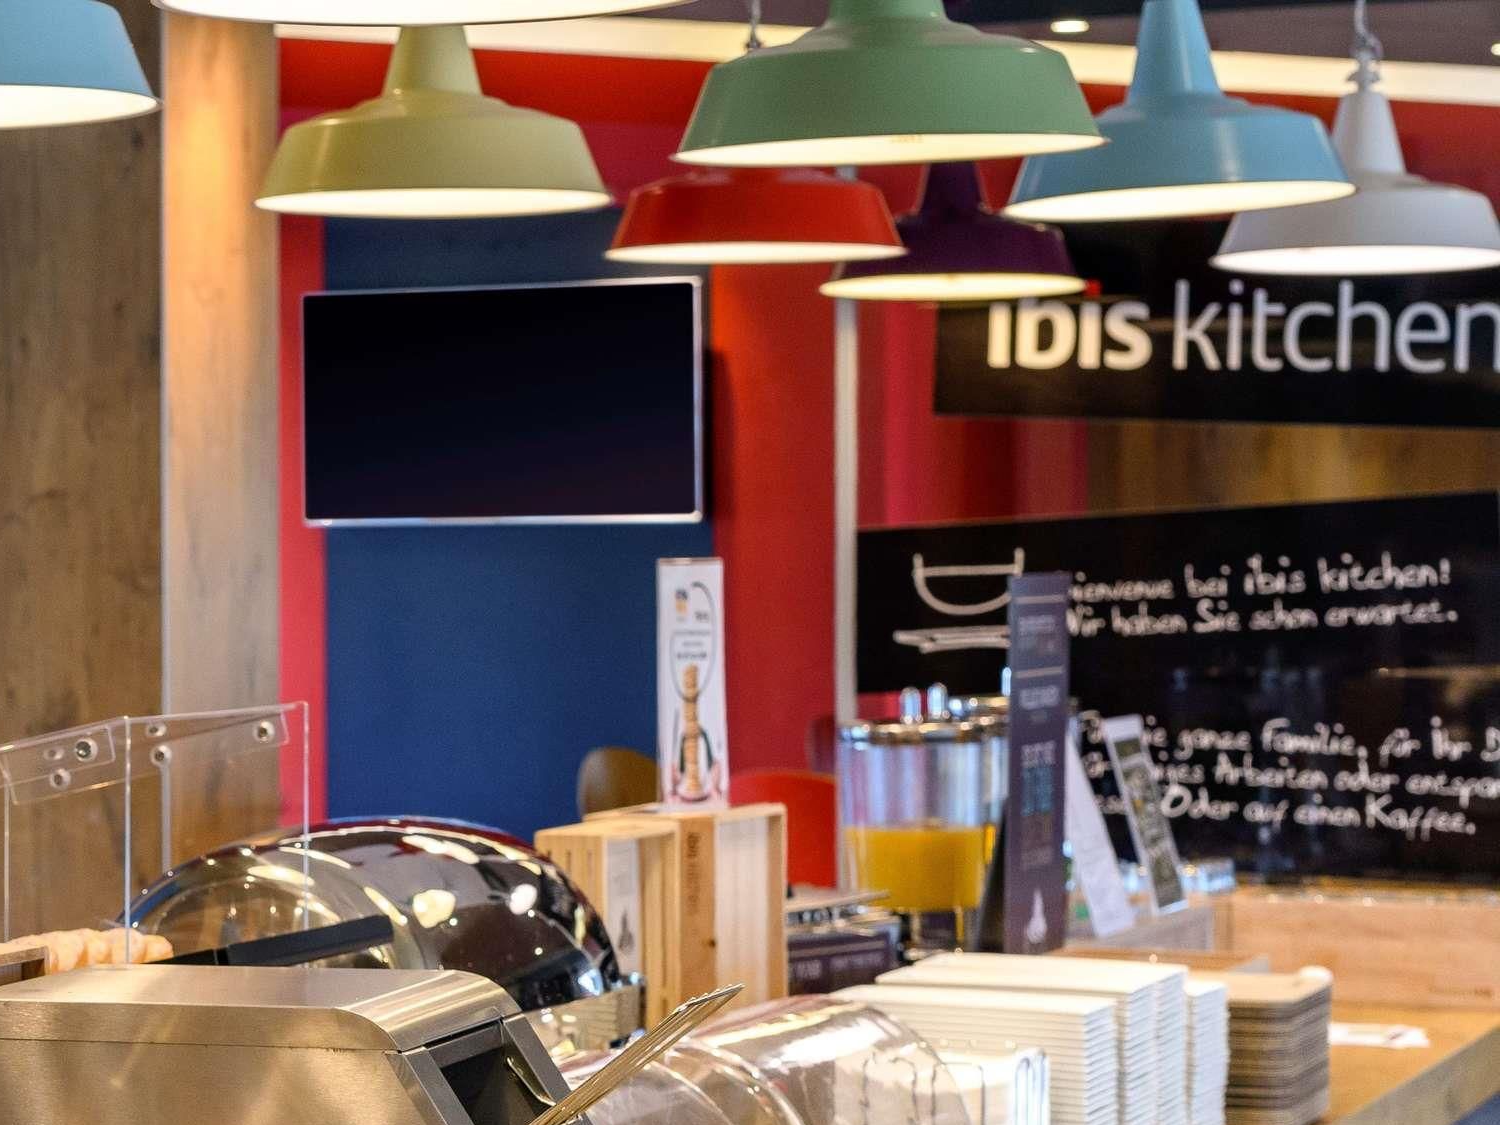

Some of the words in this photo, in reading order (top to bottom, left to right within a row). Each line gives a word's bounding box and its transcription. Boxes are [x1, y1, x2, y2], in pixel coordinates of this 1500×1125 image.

[987, 298, 1153, 371] ibis
[1171, 278, 1500, 373] kitchen
[1068, 571, 1174, 601] ienvenue
[1184, 563, 1230, 598] bei
[1243, 553, 1306, 595] ibis
[1317, 551, 1451, 593] kitchen!
[1111, 600, 1188, 637] haben
[1193, 598, 1241, 633] Sie
[1161, 784, 1239, 819] Oder
[1243, 800, 1290, 832] auf
[1294, 793, 1361, 828] einen
[1365, 793, 1476, 841] Kaffee.
